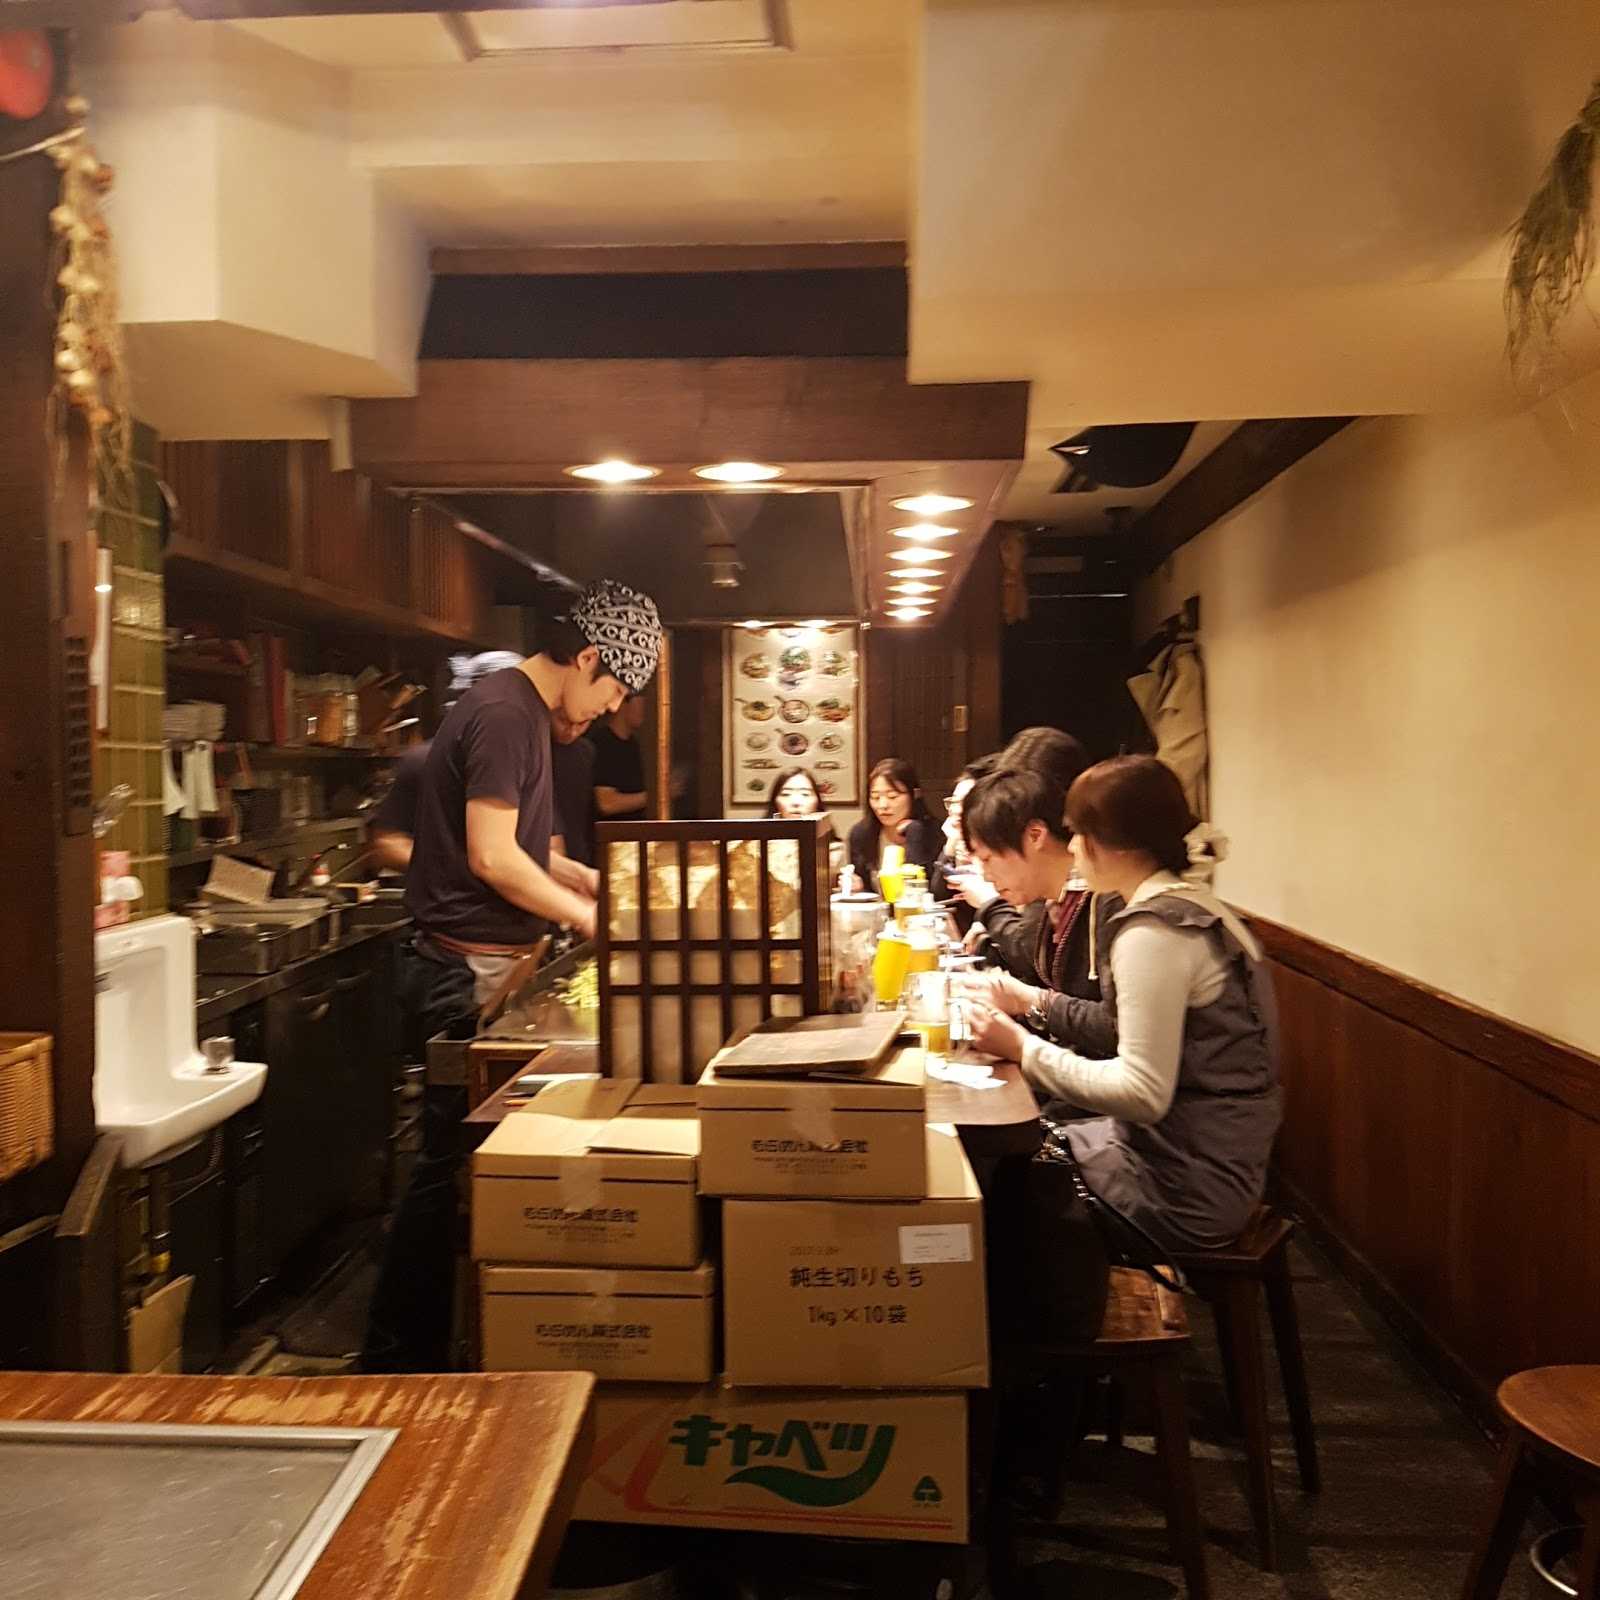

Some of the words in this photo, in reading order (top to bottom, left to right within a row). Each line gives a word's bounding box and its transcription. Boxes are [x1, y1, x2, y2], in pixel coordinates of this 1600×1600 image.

[789, 1266, 923, 1288] 純生切りもち
[669, 1414, 898, 1507] キャベツ
